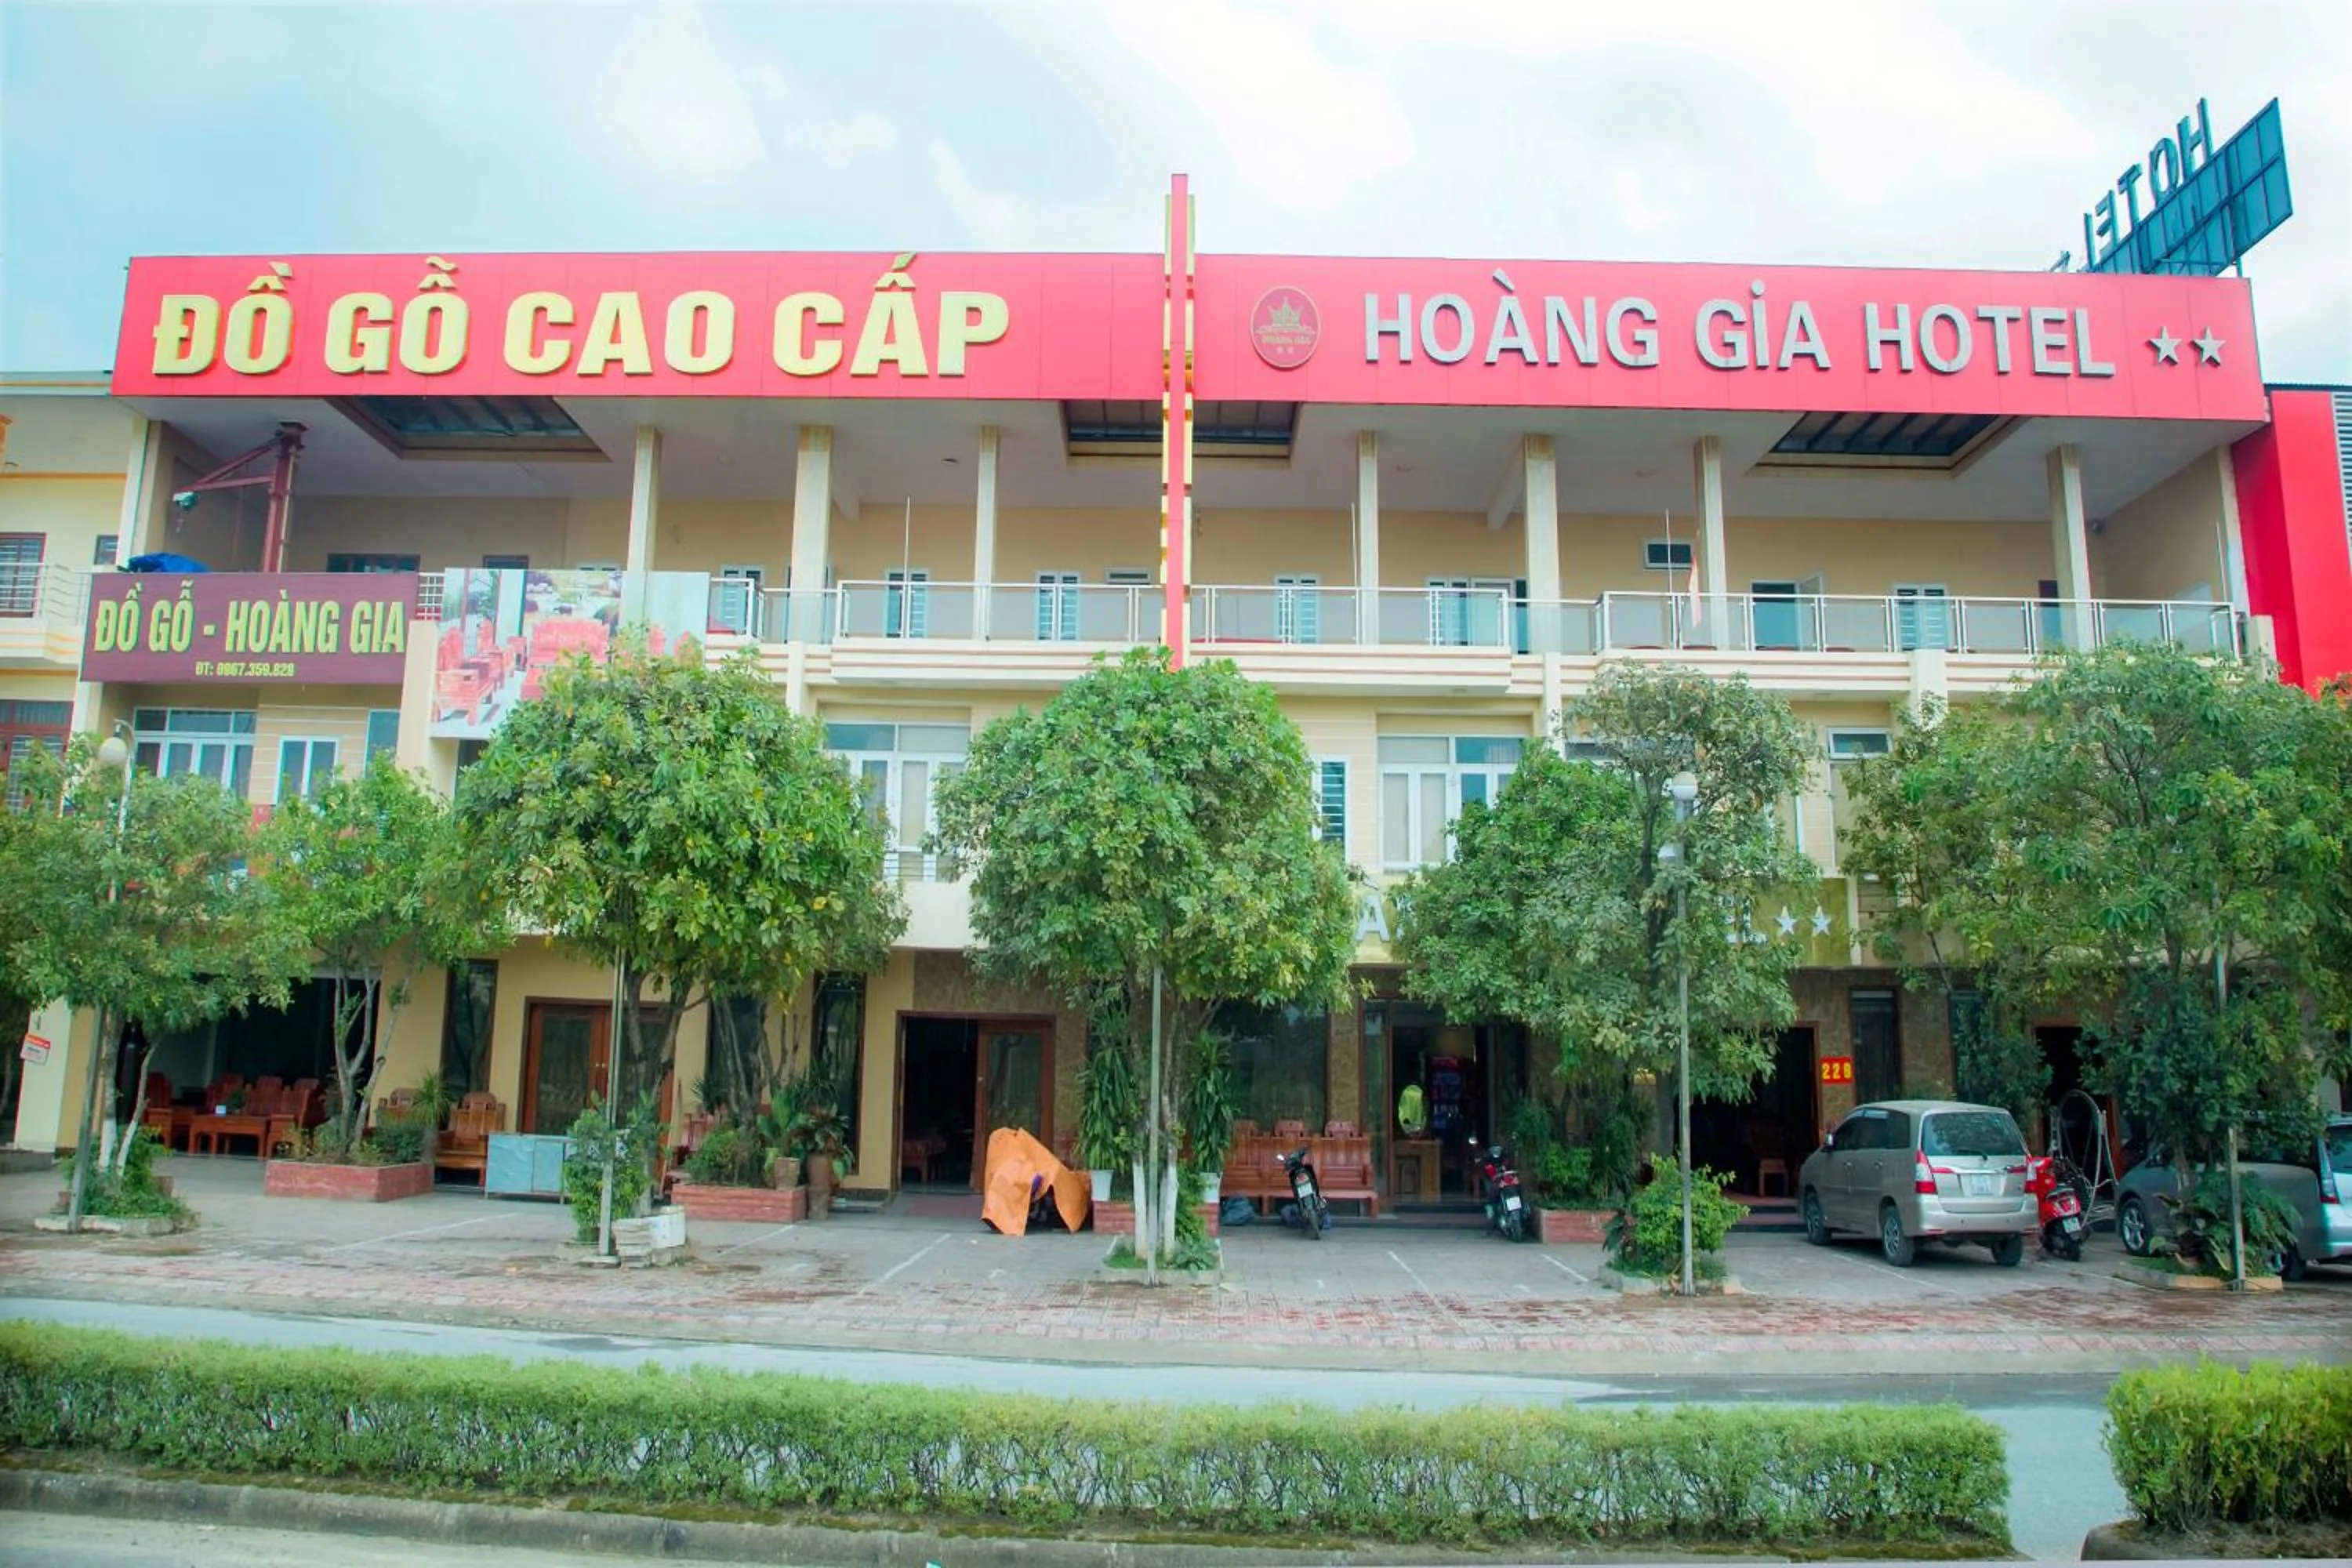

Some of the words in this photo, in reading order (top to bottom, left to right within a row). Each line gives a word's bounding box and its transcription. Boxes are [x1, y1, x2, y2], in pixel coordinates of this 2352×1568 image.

[151, 260, 294, 375] ĐỒ
[324, 255, 470, 375] GỖ
[503, 291, 735, 376] CAO
[772, 251, 1010, 377] CẤP
[1363, 268, 1660, 368] HOÀNG
[1864, 301, 2116, 377] HOTEL
[94, 581, 143, 652] ĐỒ
[148, 579, 195, 653] GỖ
[225, 589, 340, 654] HOÀNG
[349, 600, 405, 654] GIA
